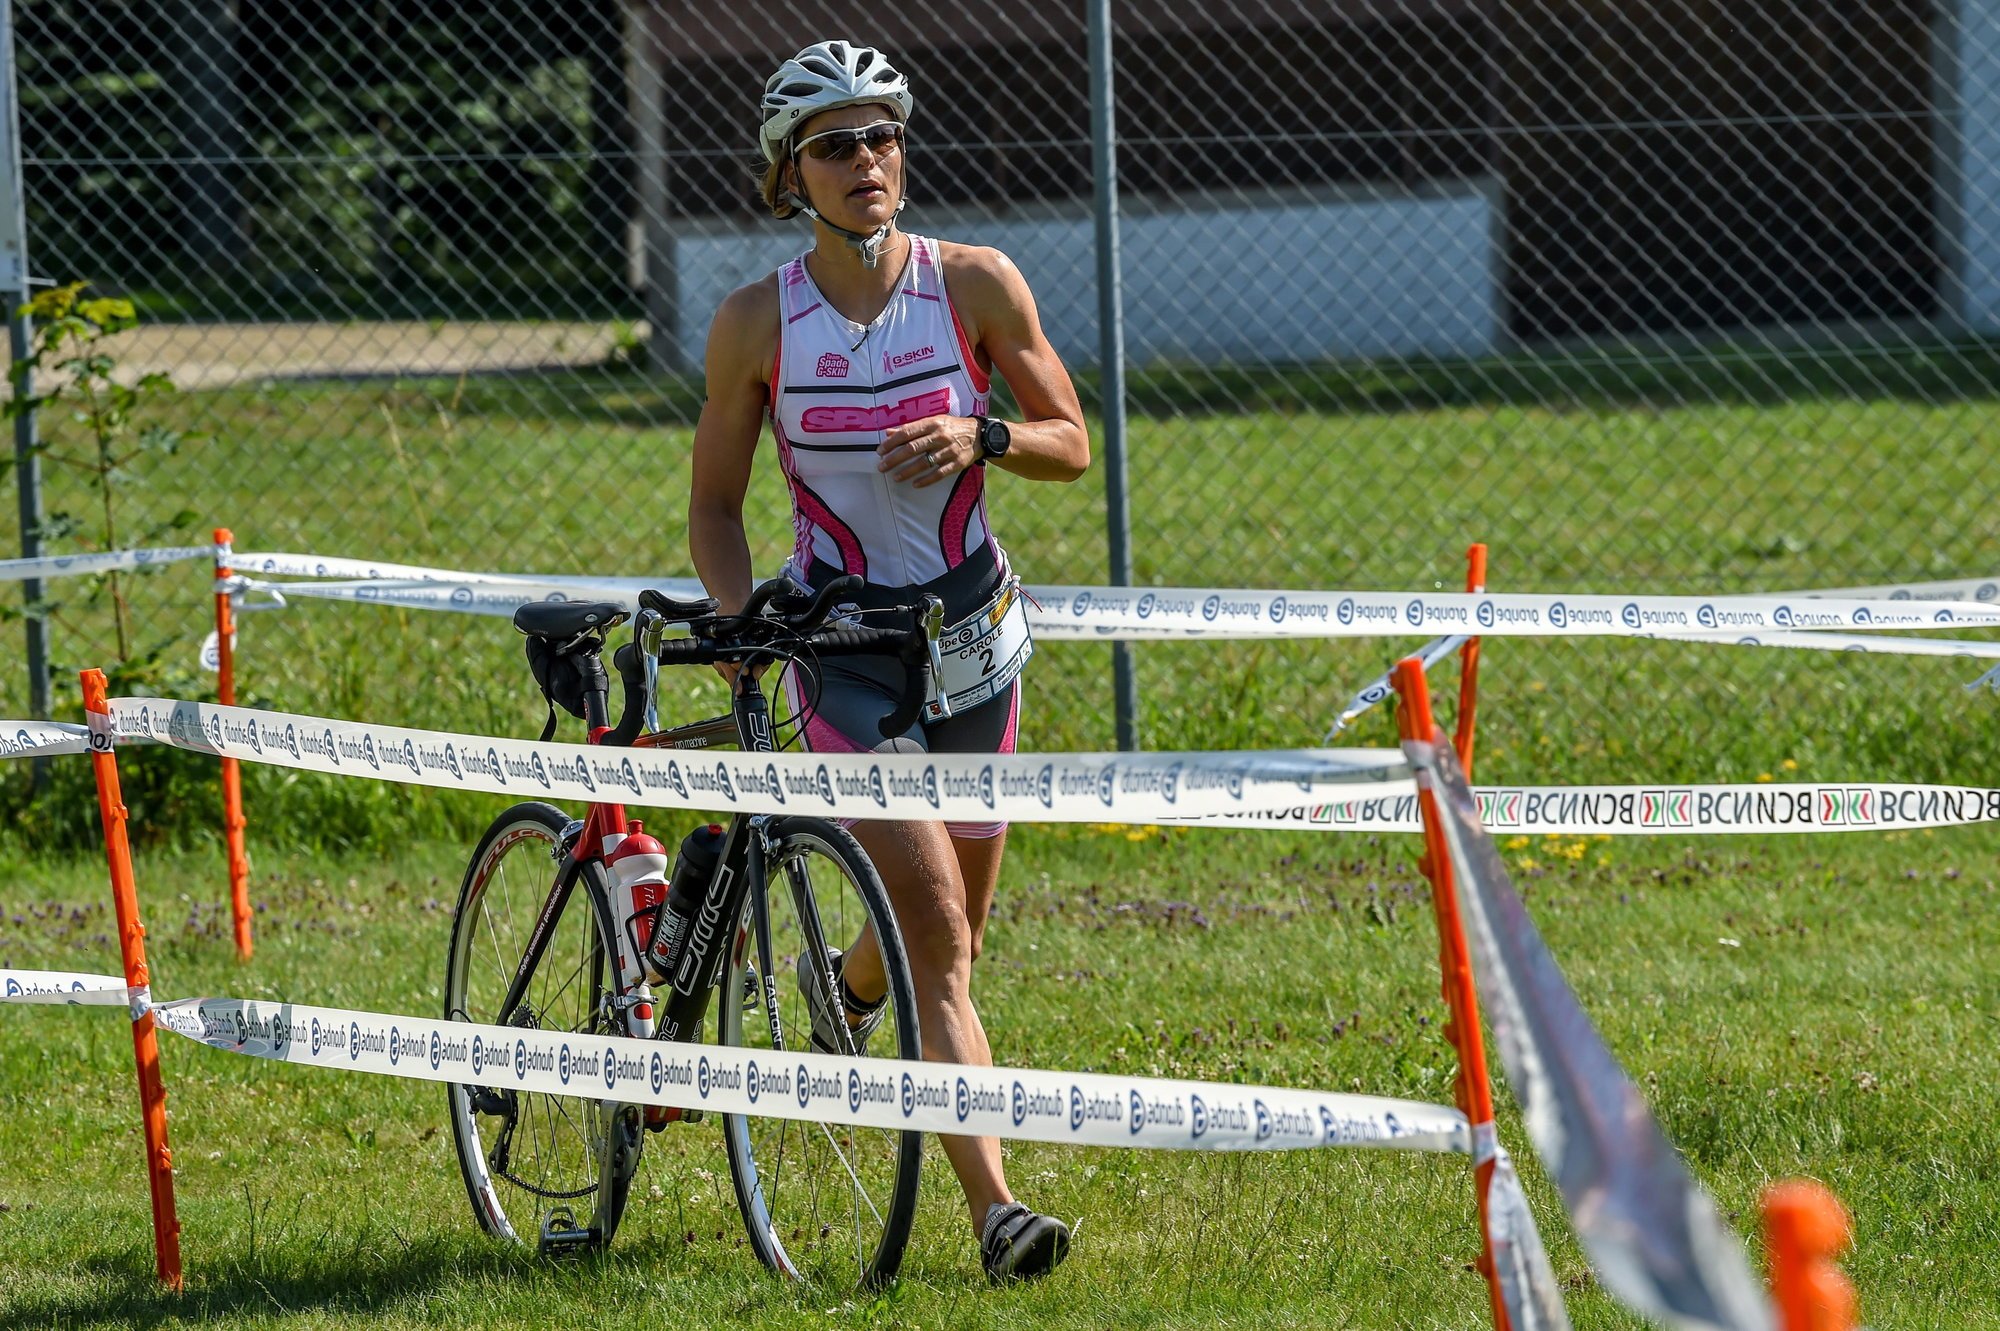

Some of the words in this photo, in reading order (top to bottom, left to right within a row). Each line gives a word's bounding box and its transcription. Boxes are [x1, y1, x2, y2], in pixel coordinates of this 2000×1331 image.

[817, 368, 847, 377] G-SKIN
[819, 357, 848, 369] Spade
[960, 625, 1003, 660] CAROLE
[979, 648, 996, 676] 2
[519, 954, 530, 976] style
[529, 922, 545, 956] passion
[543, 883, 563, 923] precision
[675, 915, 689, 941] COMPANY
[765, 974, 783, 1043] EASTON
[247, 1017, 271, 1039] groupe
[284, 1020, 308, 1043] groupe
[322, 1023, 346, 1048] groupe
[361, 1028, 385, 1053] groupe
[400, 1032, 426, 1058] groupe
[441, 1036, 467, 1062] groupe
[483, 1041, 510, 1067] groupe
[527, 1045, 554, 1072] groupe
[571, 1049, 599, 1077] groupe
[617, 1054, 645, 1081] groupe
[663, 1058, 693, 1085] groupe
[711, 1062, 741, 1090] groupe
[761, 1067, 791, 1094] groupe
[811, 1071, 842, 1099] groupe
[862, 1075, 896, 1104] groupe
[916, 1080, 950, 1107] groupe
[971, 1084, 1006, 1112] groupe
[1028, 1088, 1063, 1116] groupe
[1087, 1092, 1123, 1121] groupe
